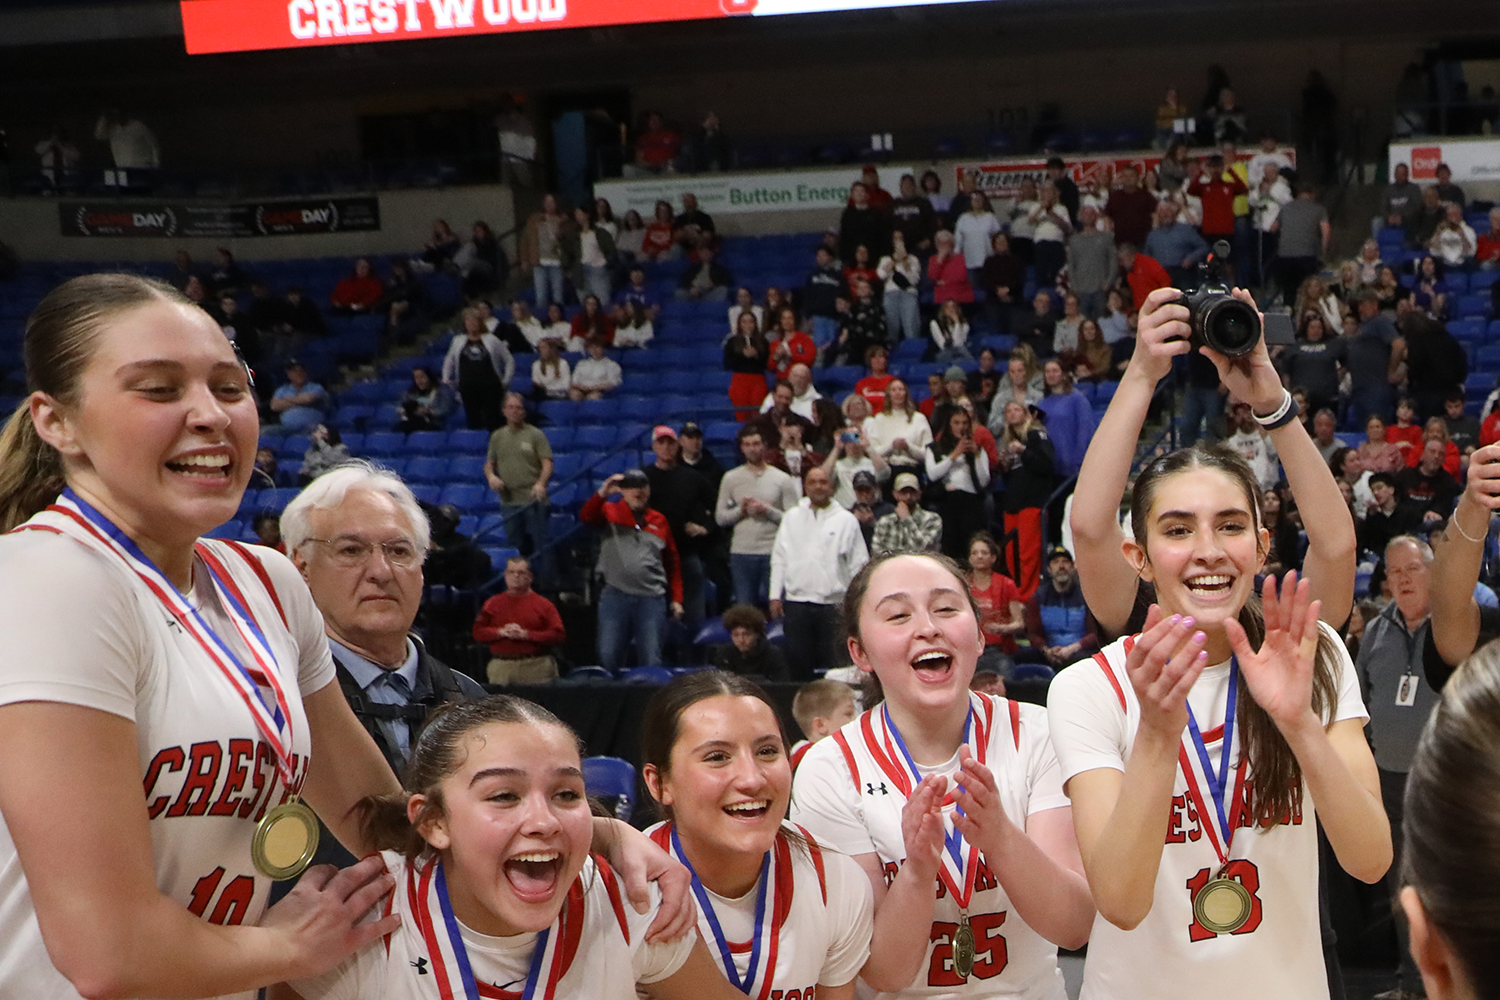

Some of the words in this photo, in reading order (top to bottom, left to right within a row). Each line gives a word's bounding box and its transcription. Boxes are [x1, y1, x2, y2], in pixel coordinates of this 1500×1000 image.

[287, 0, 567, 39] CRESTWOOD
[729, 187, 792, 206] Button
[795, 182, 850, 204] Energ
[927, 910, 1009, 987] 25
